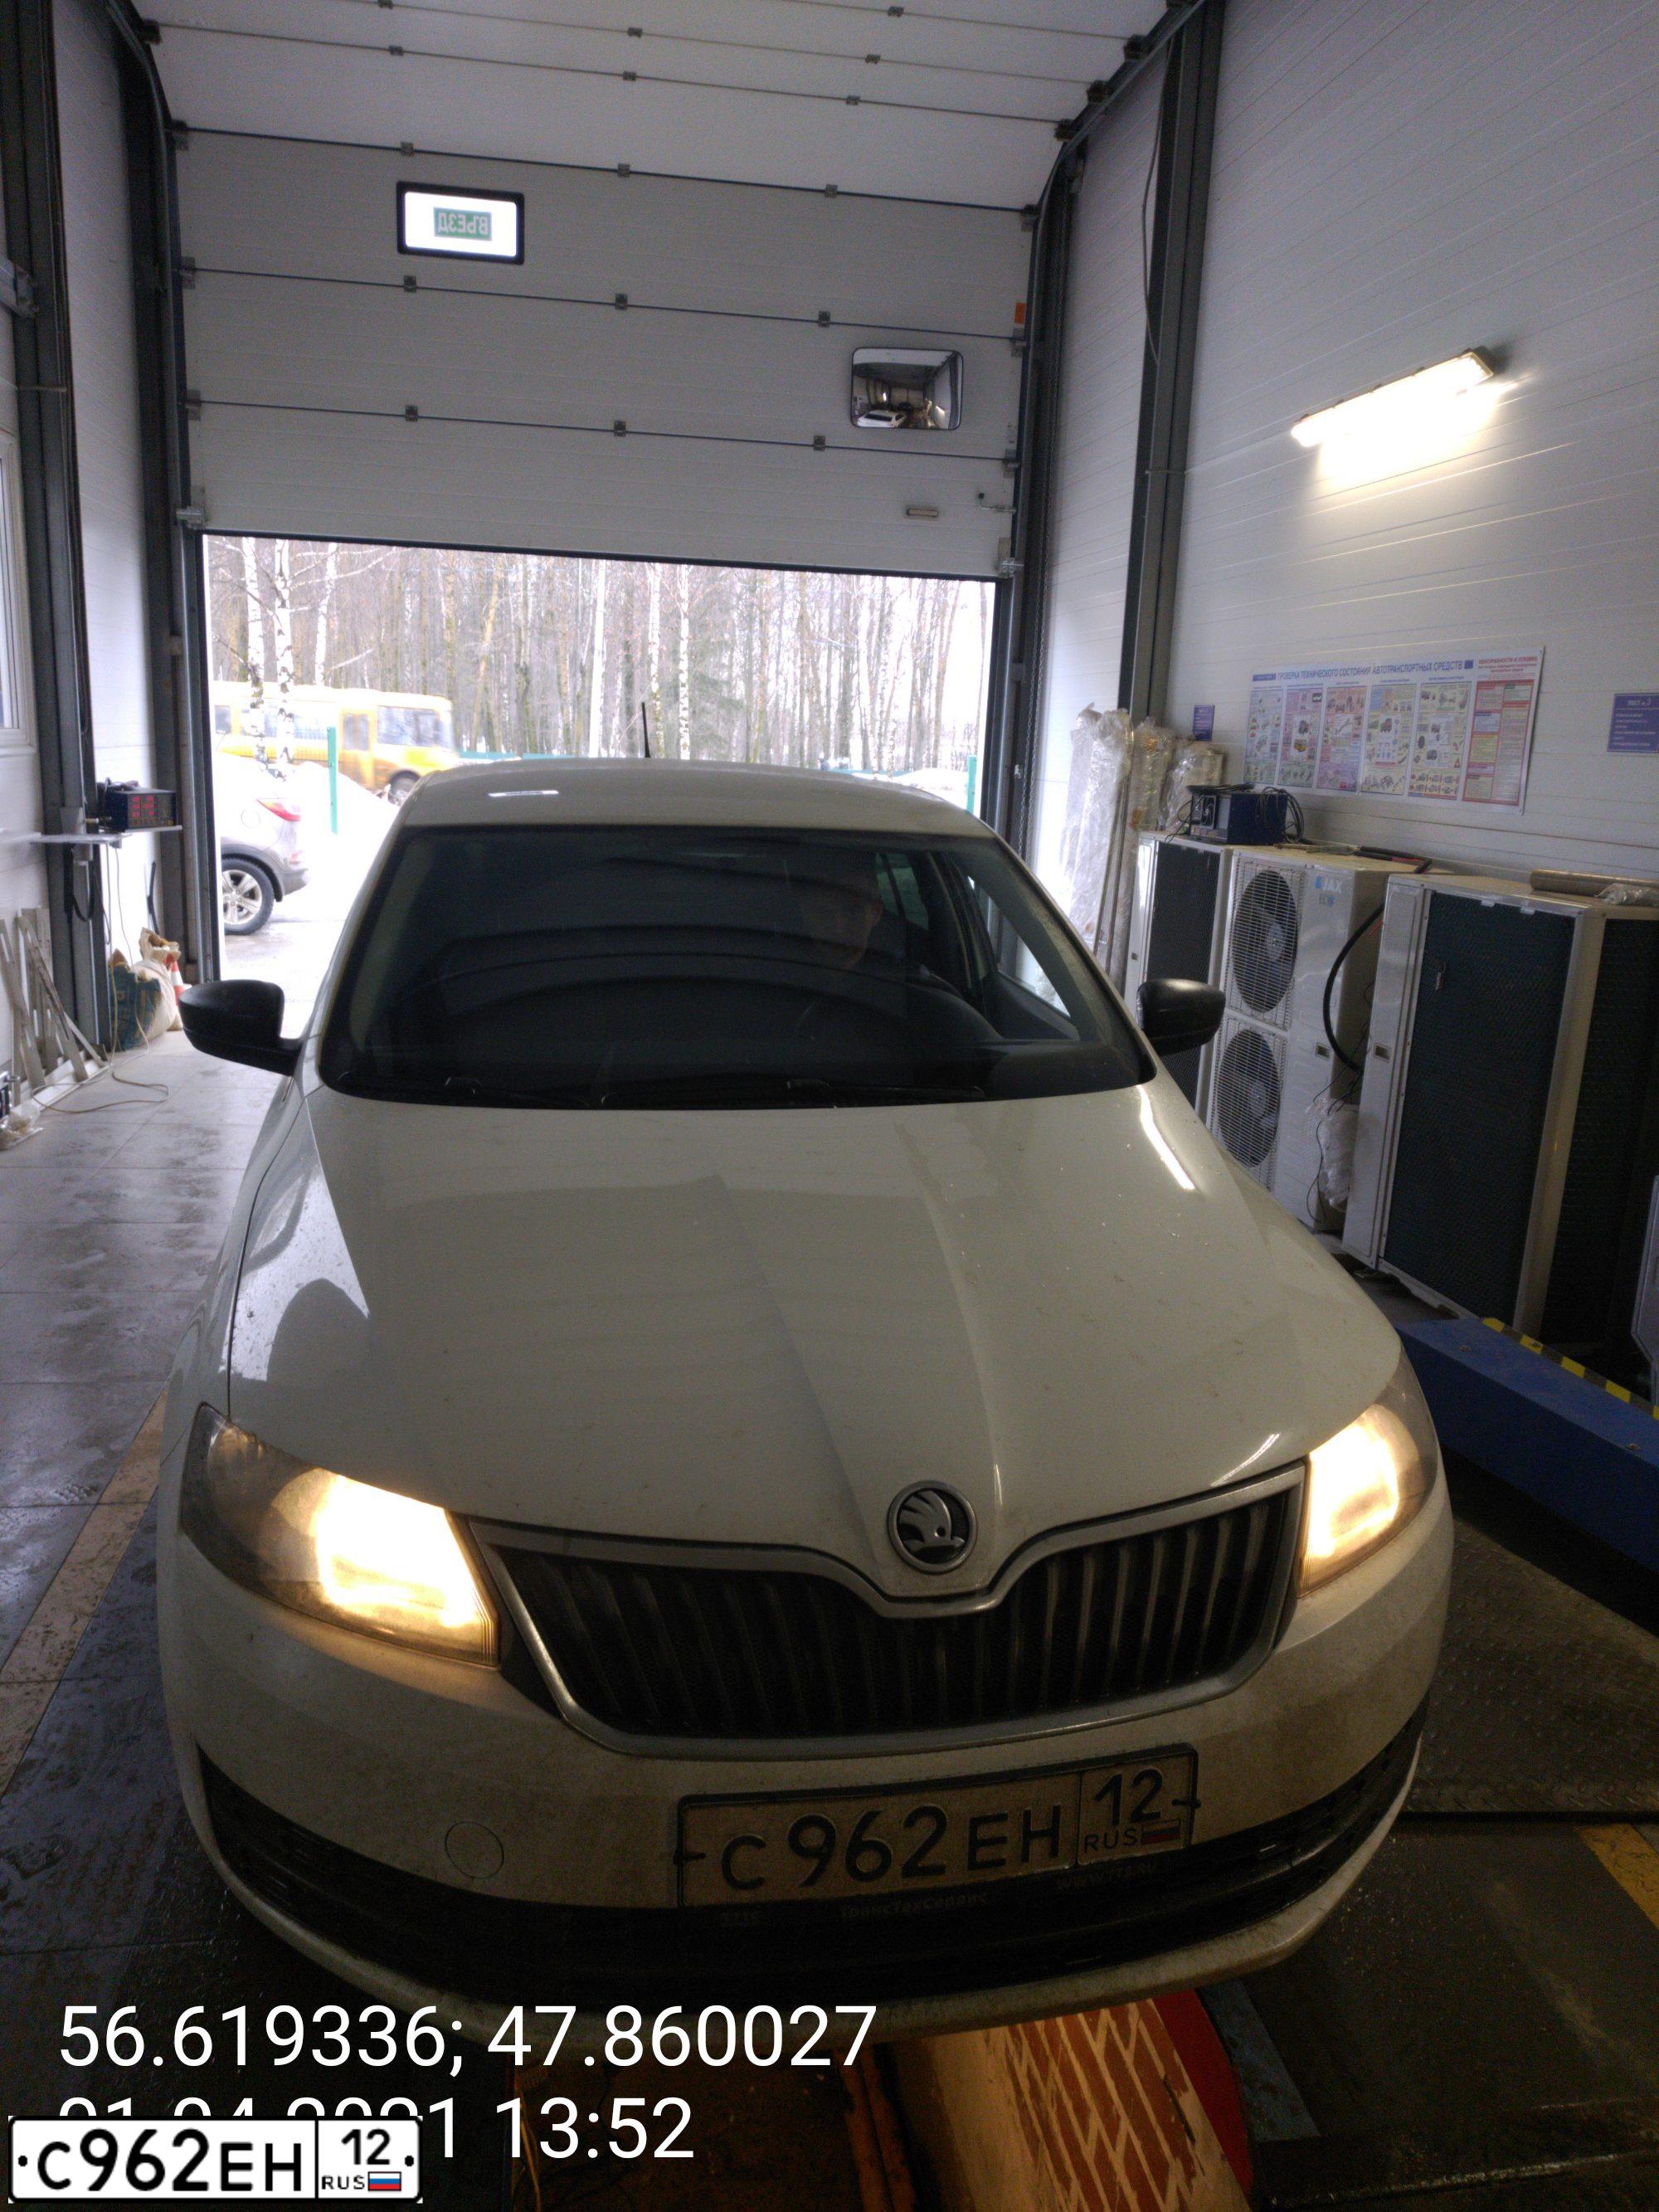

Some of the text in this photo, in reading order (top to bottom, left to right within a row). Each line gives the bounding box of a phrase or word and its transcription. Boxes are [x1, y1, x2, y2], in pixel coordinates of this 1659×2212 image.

[1301, 668, 1338, 679] ТЕХНИЧЕСКОГО
[1339, 666, 1370, 677] СОСТОЯНИЯ
[1372, 662, 1432, 675] АВТОТРАНСПОРТНЫХ
[1433, 660, 1463, 671] СРЕДСТВ
[1093, 1768, 1163, 1826] 12
[1083, 1827, 1140, 1854] RUS
